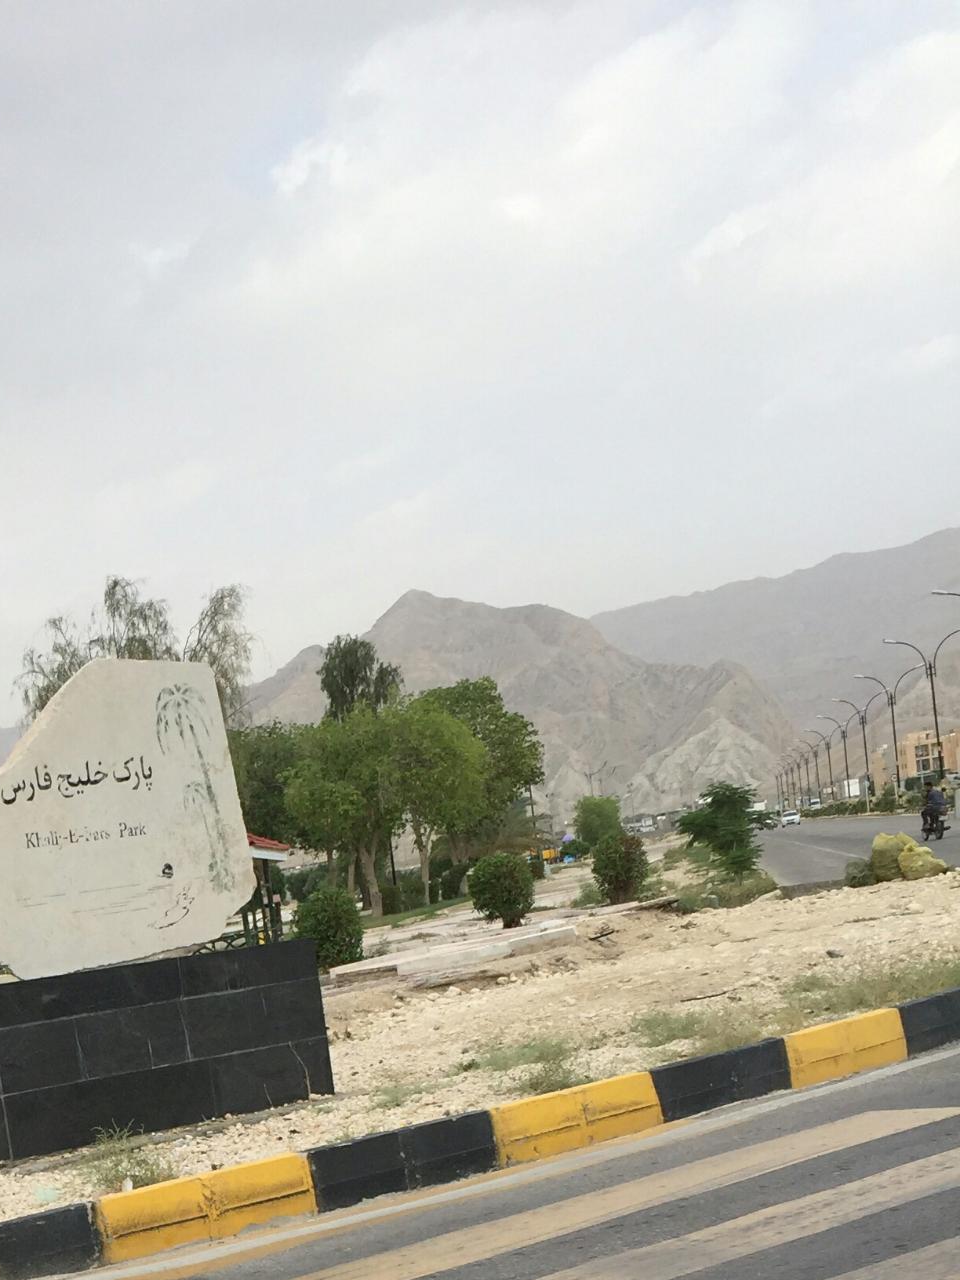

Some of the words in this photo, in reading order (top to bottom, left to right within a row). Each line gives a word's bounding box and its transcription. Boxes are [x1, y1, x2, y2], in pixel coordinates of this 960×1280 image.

[0, 764, 53, 805] فارس
[56, 760, 109, 798] خلیج
[112, 755, 153, 791] پارک
[118, 822, 147, 839] Park
